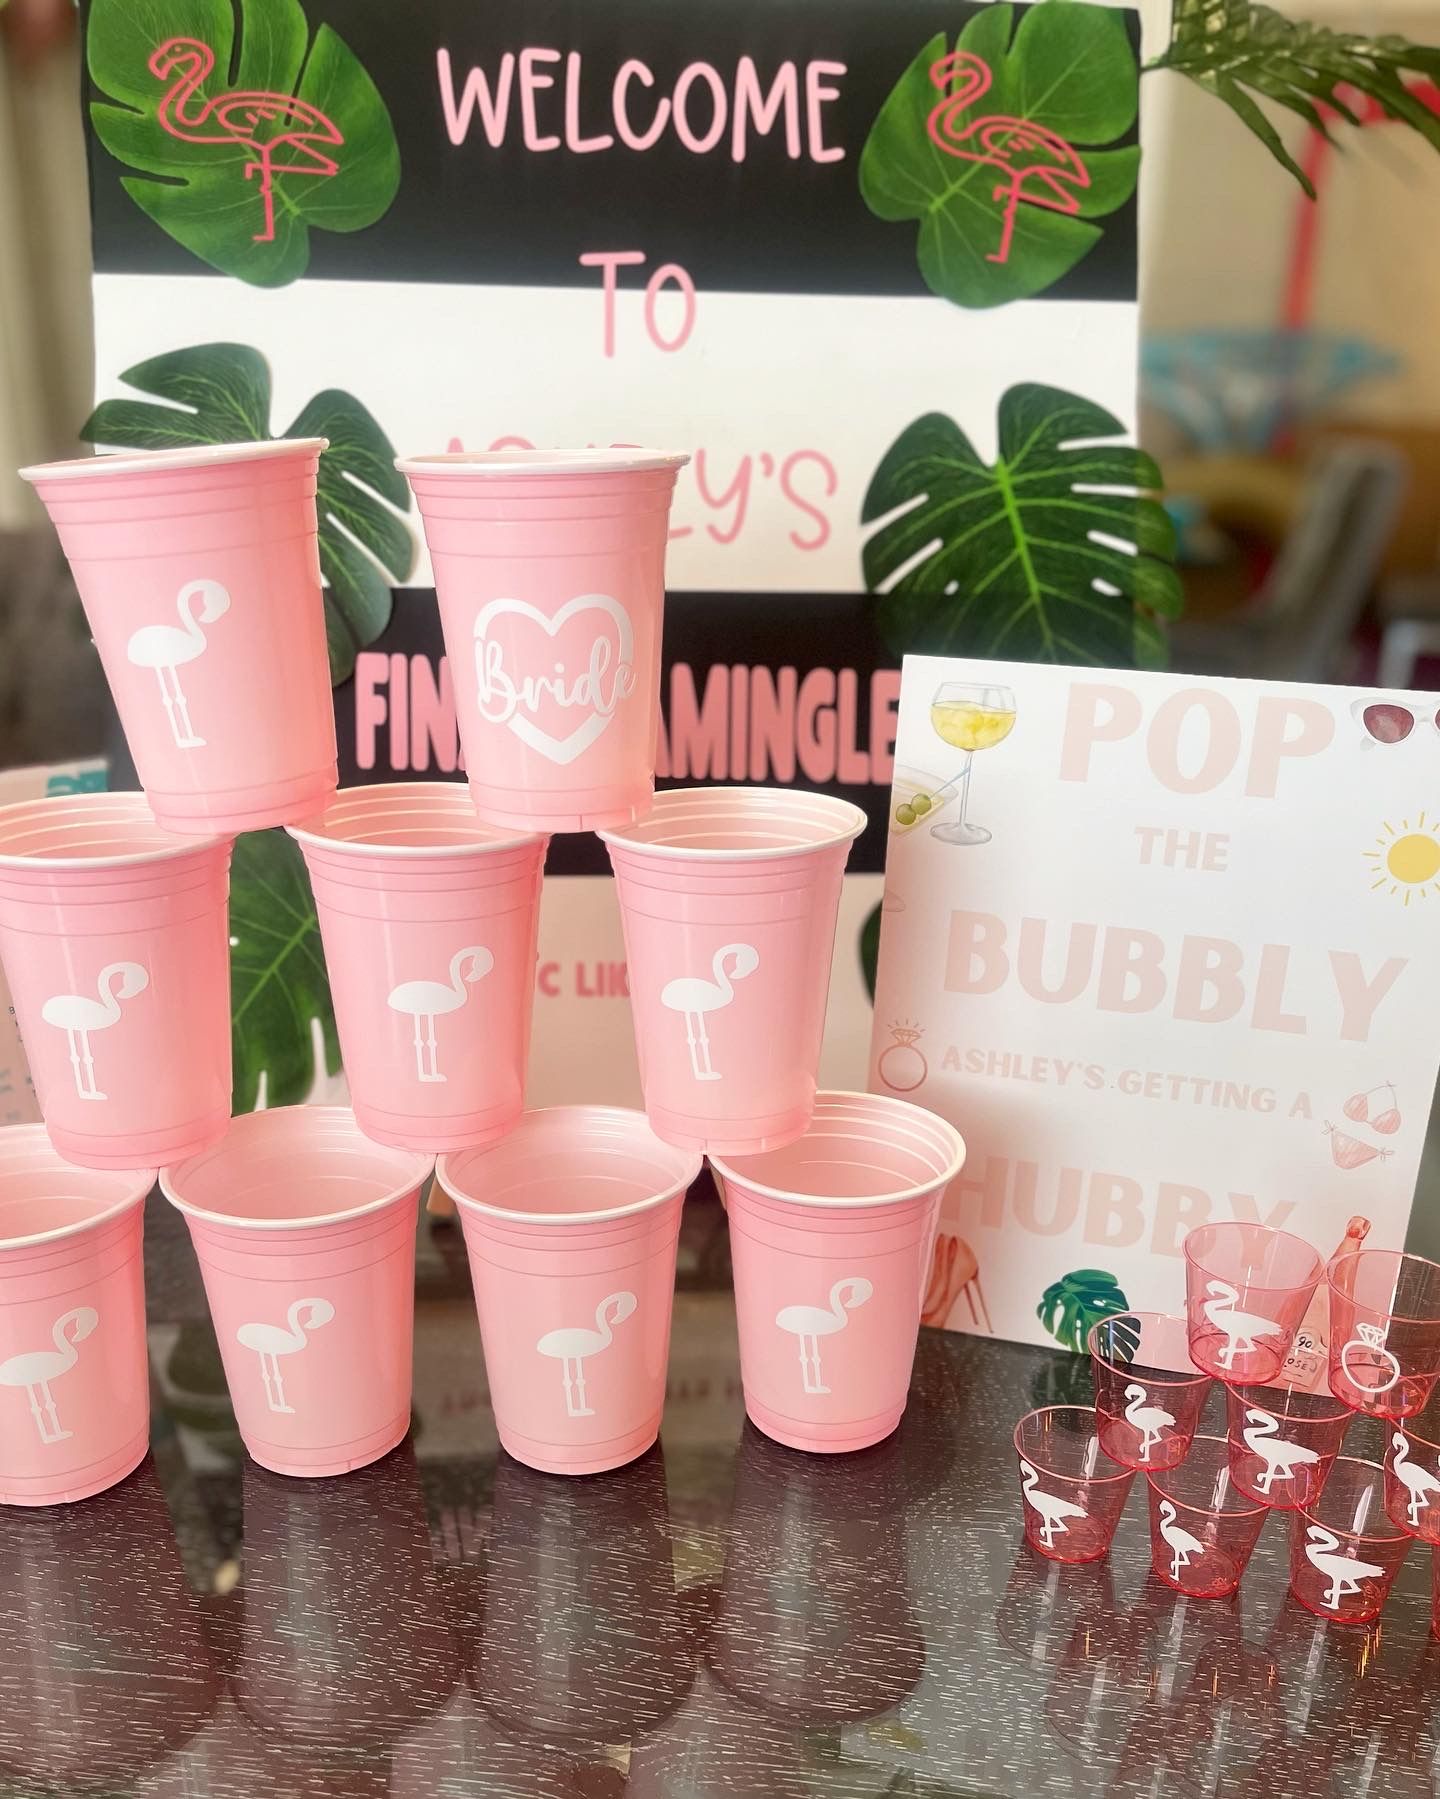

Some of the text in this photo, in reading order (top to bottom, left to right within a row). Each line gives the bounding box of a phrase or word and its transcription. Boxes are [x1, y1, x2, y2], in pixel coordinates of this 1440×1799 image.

[437, 47, 847, 163] WELCOME
[579, 251, 696, 358] TO
[355, 652, 902, 786] FIN MINGLE
[475, 635, 639, 724] Bride
[1058, 682, 1336, 799] POP
[1134, 826, 1231, 872] THE
[943, 910, 1410, 1043] BUBBLY
[941, 1046, 1313, 1120] ASHLEY'S GETTING A
[941, 1156, 1297, 1272] HUBBY
